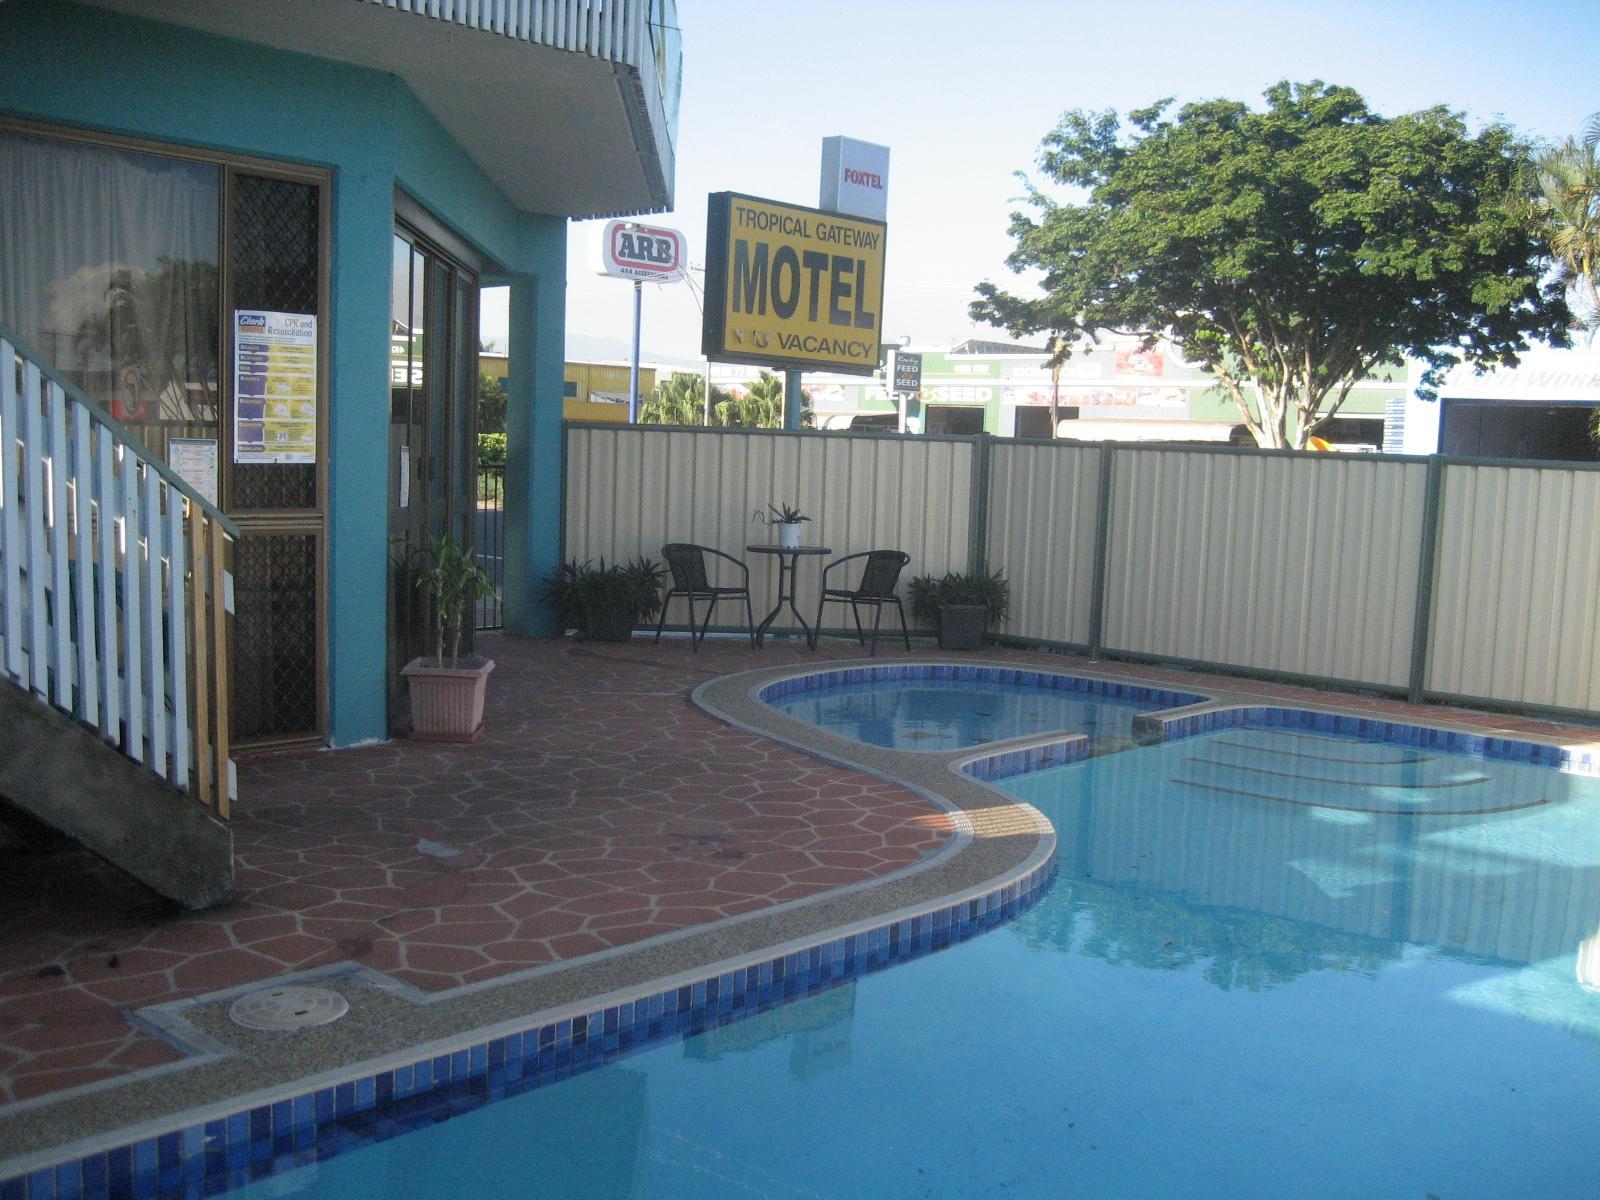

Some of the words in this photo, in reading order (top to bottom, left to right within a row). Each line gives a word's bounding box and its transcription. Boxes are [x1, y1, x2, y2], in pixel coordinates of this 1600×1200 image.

[844, 168, 883, 190] FOXTEL
[737, 207, 812, 238] TROPICAL
[816, 222, 880, 250] GATEWAY
[618, 233, 671, 263] ARB
[732, 239, 875, 330] MOTEL
[240, 315, 265, 326] Clark
[284, 318, 299, 327] CPR
[299, 319, 313, 328] and
[268, 326, 313, 337] Resuscitation
[777, 331, 873, 359] VACANCY
[896, 364, 919, 373] FEED
[895, 378, 918, 387] SEED
